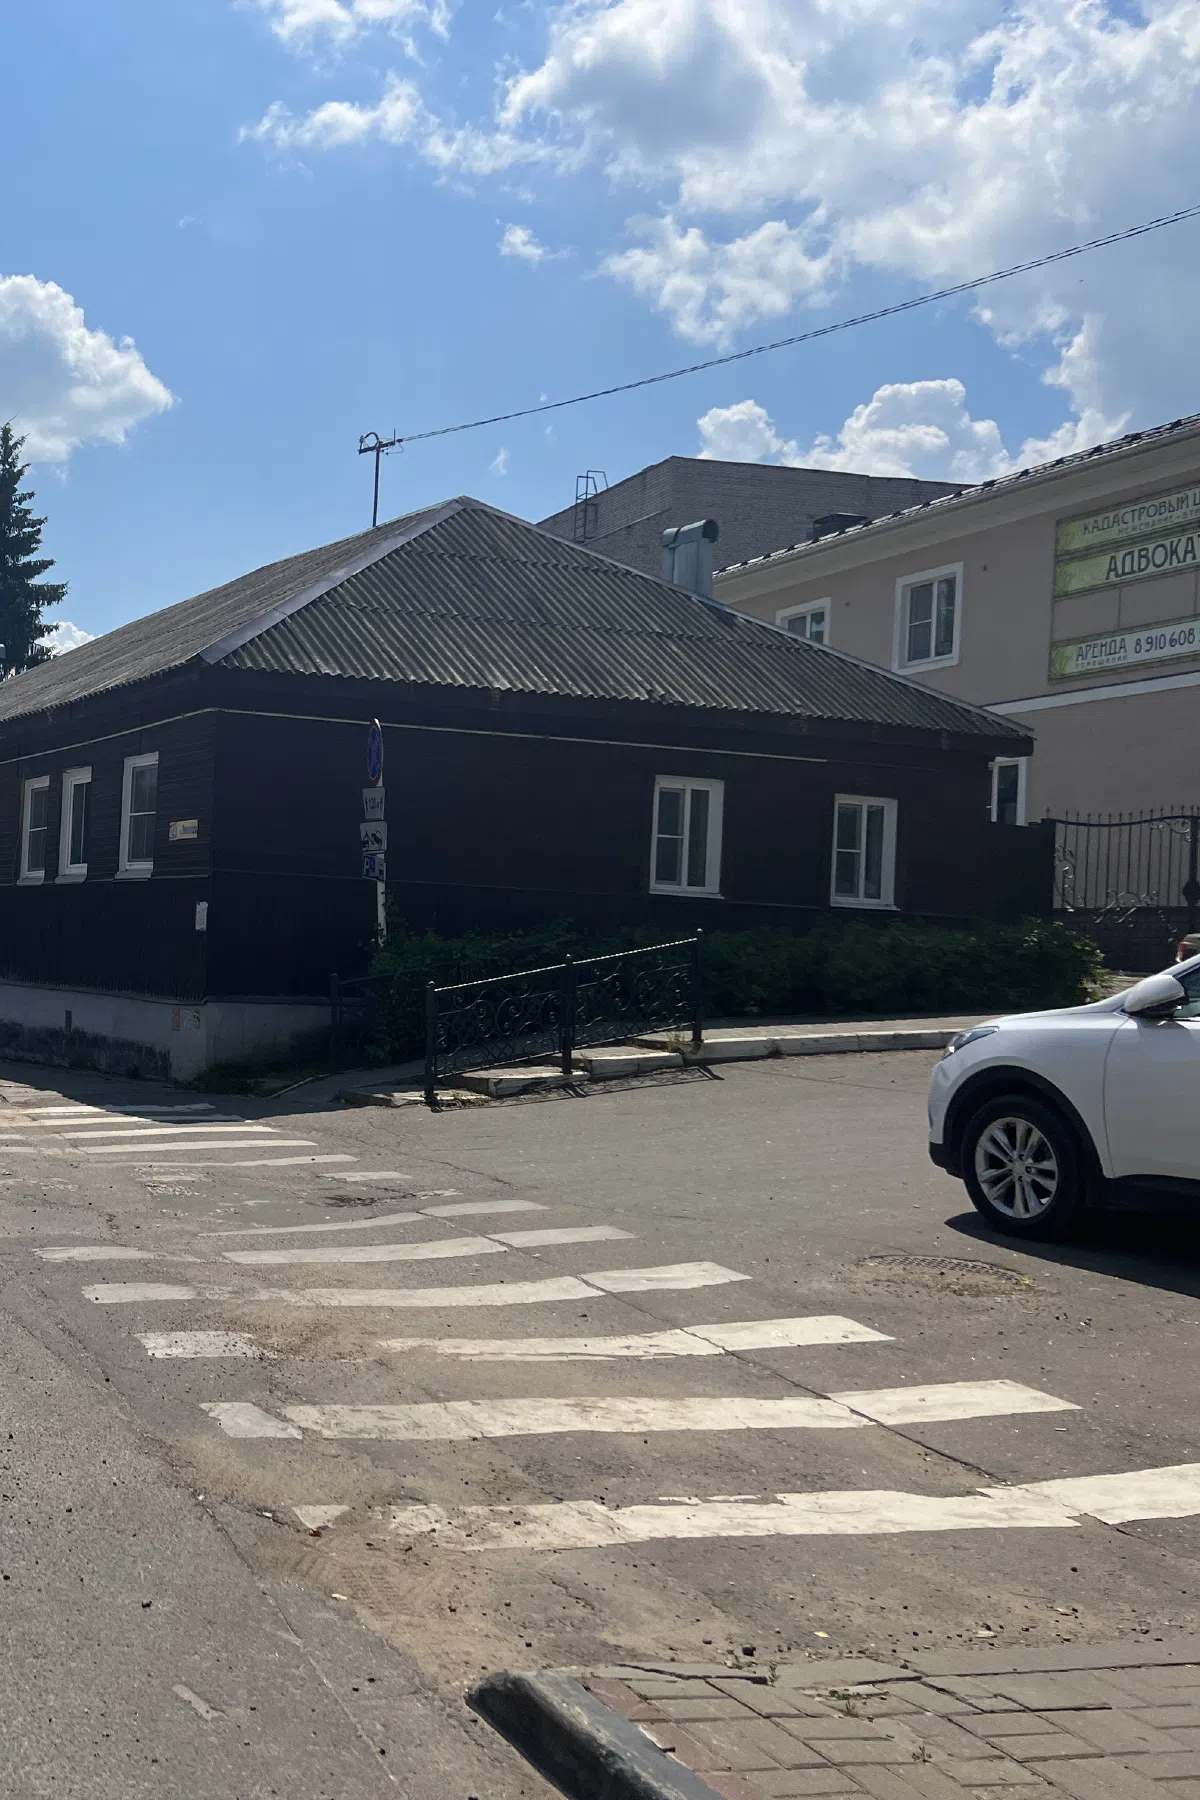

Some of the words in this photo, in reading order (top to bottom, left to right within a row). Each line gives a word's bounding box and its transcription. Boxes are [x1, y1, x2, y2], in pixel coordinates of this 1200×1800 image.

[1083, 493, 1189, 535] КАДАСТРОВЫЙ
[1105, 533, 1200, 581] АДВОКА
[1076, 637, 1127, 662] АРЕНДА
